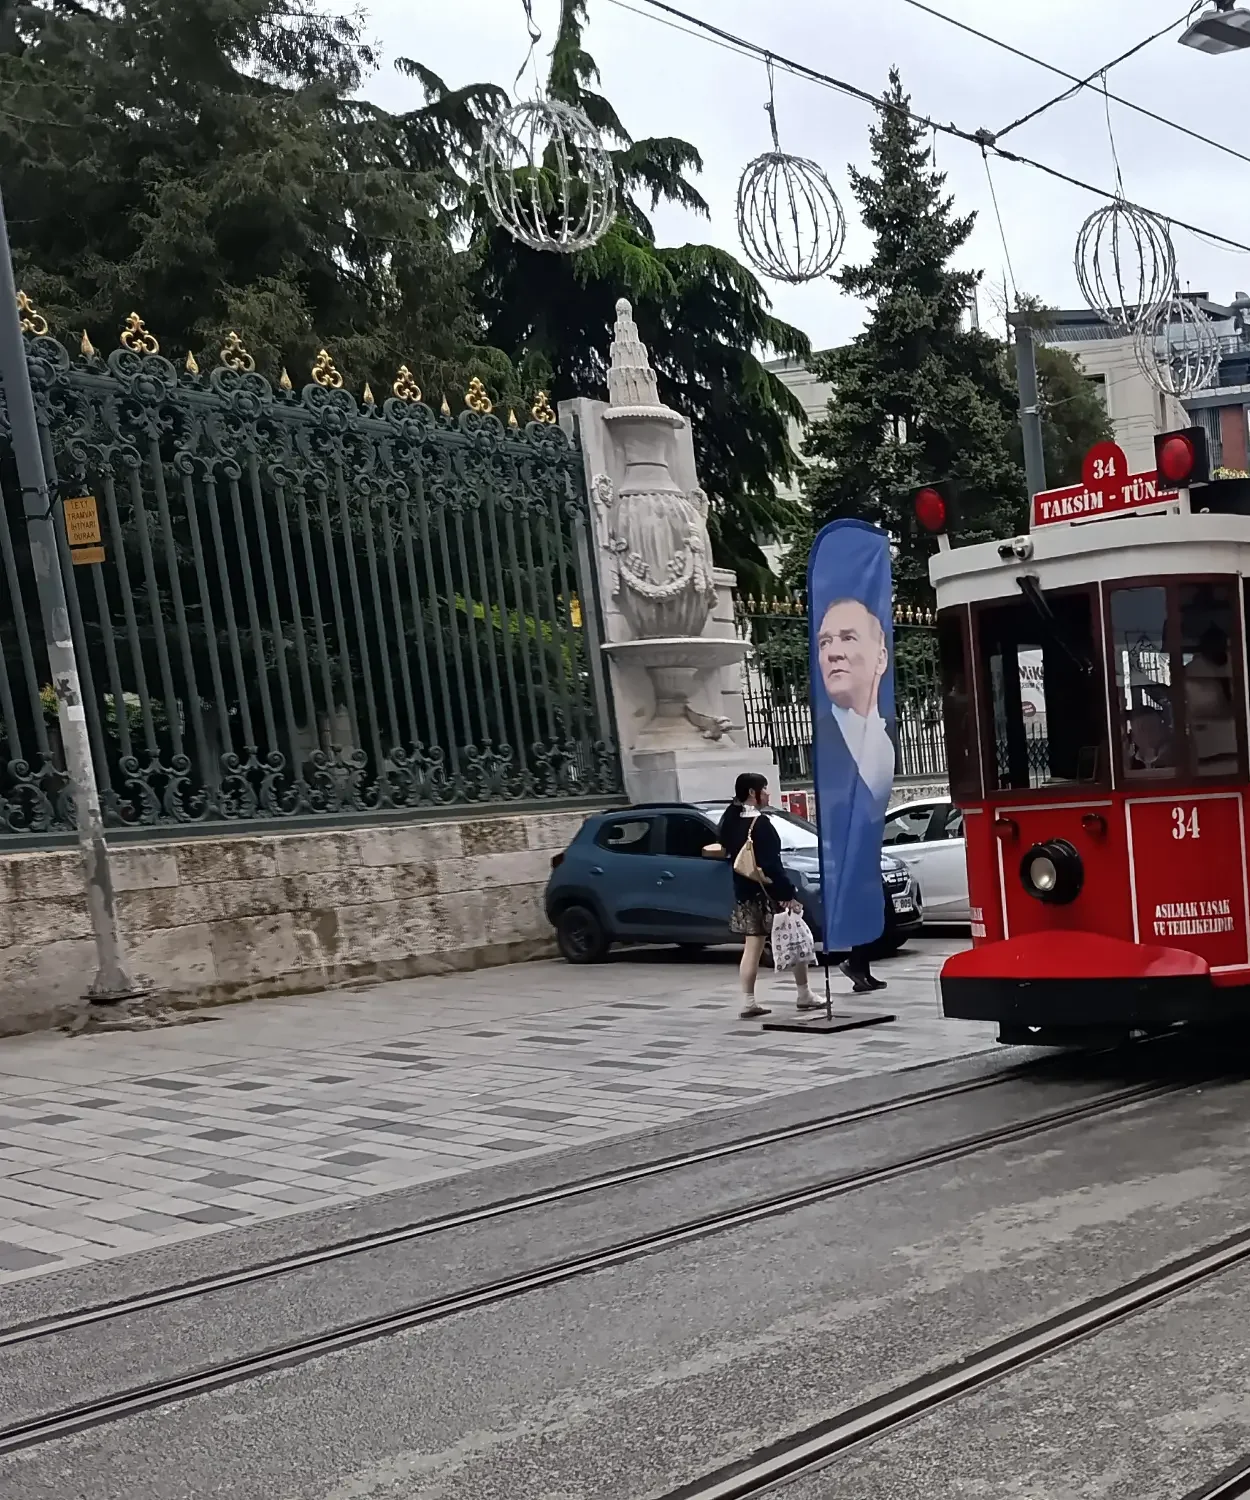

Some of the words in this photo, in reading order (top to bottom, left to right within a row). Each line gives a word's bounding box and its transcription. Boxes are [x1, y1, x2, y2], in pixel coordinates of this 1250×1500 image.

[1093, 457, 1116, 479] 34
[1041, 489, 1103, 519] TAKSİM
[1121, 478, 1178, 503] TÜN
[67, 510, 95, 520] TRAMVAY
[73, 532, 95, 540] DURAK
[1172, 807, 1200, 839] 34
[1156, 902, 1198, 918] ASILMAK
[1200, 900, 1230, 916] YASAK
[1153, 921, 1166, 936] VE
